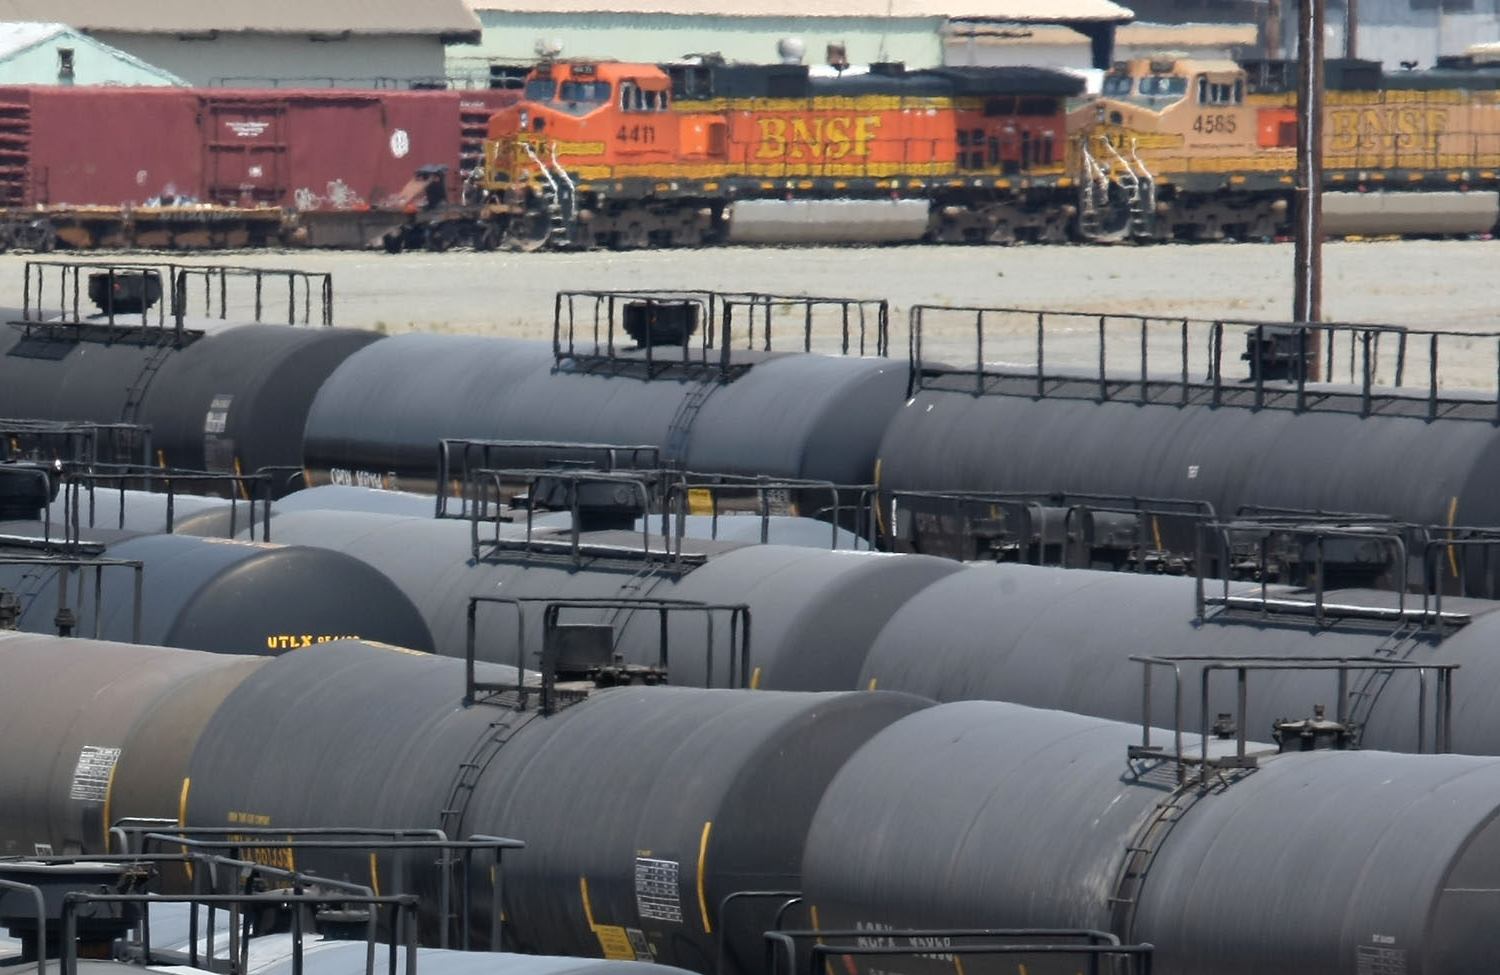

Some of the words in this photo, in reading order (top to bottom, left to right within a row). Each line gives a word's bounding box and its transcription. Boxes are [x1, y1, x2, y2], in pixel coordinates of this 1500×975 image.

[616, 124, 656, 144] 4411
[755, 115, 882, 160] BNSF
[1329, 106, 1448, 152] BNSF
[268, 634, 312, 648] UTLX
